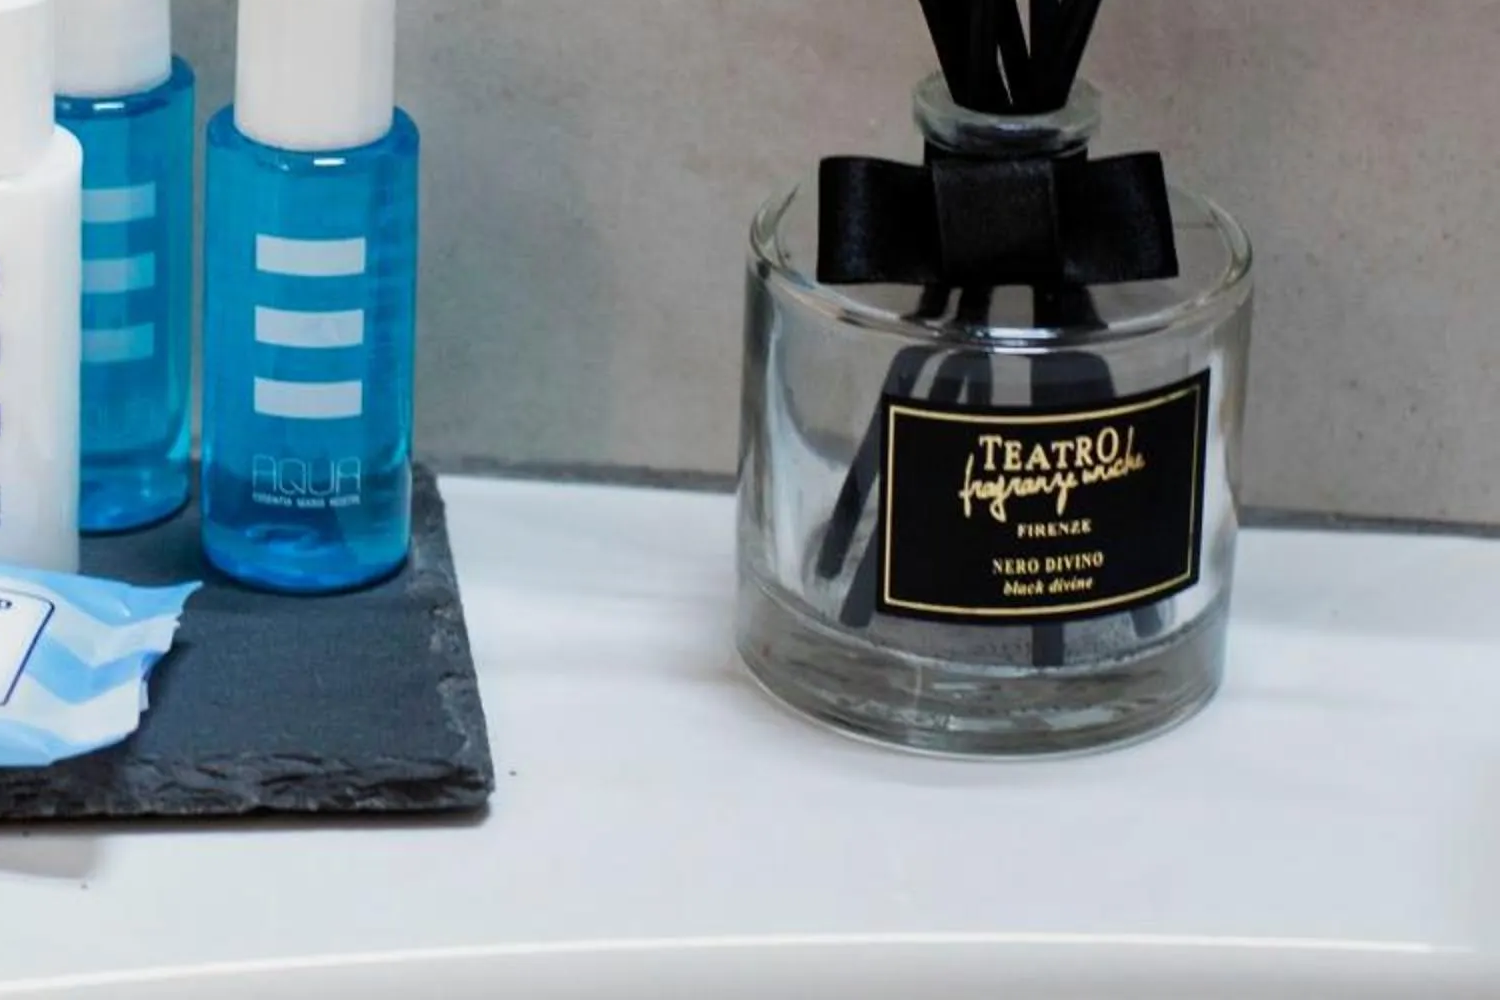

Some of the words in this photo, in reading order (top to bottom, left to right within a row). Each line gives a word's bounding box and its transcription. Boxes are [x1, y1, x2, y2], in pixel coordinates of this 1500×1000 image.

[979, 426, 1119, 471] TEATRO
[252, 453, 361, 495] AQUA
[1017, 518, 1092, 538] FIRENZE
[992, 557, 1040, 575] NERO
[1045, 551, 1104, 573] DIVINO
[1003, 580, 1044, 596] black
[1049, 576, 1092, 593] divine
